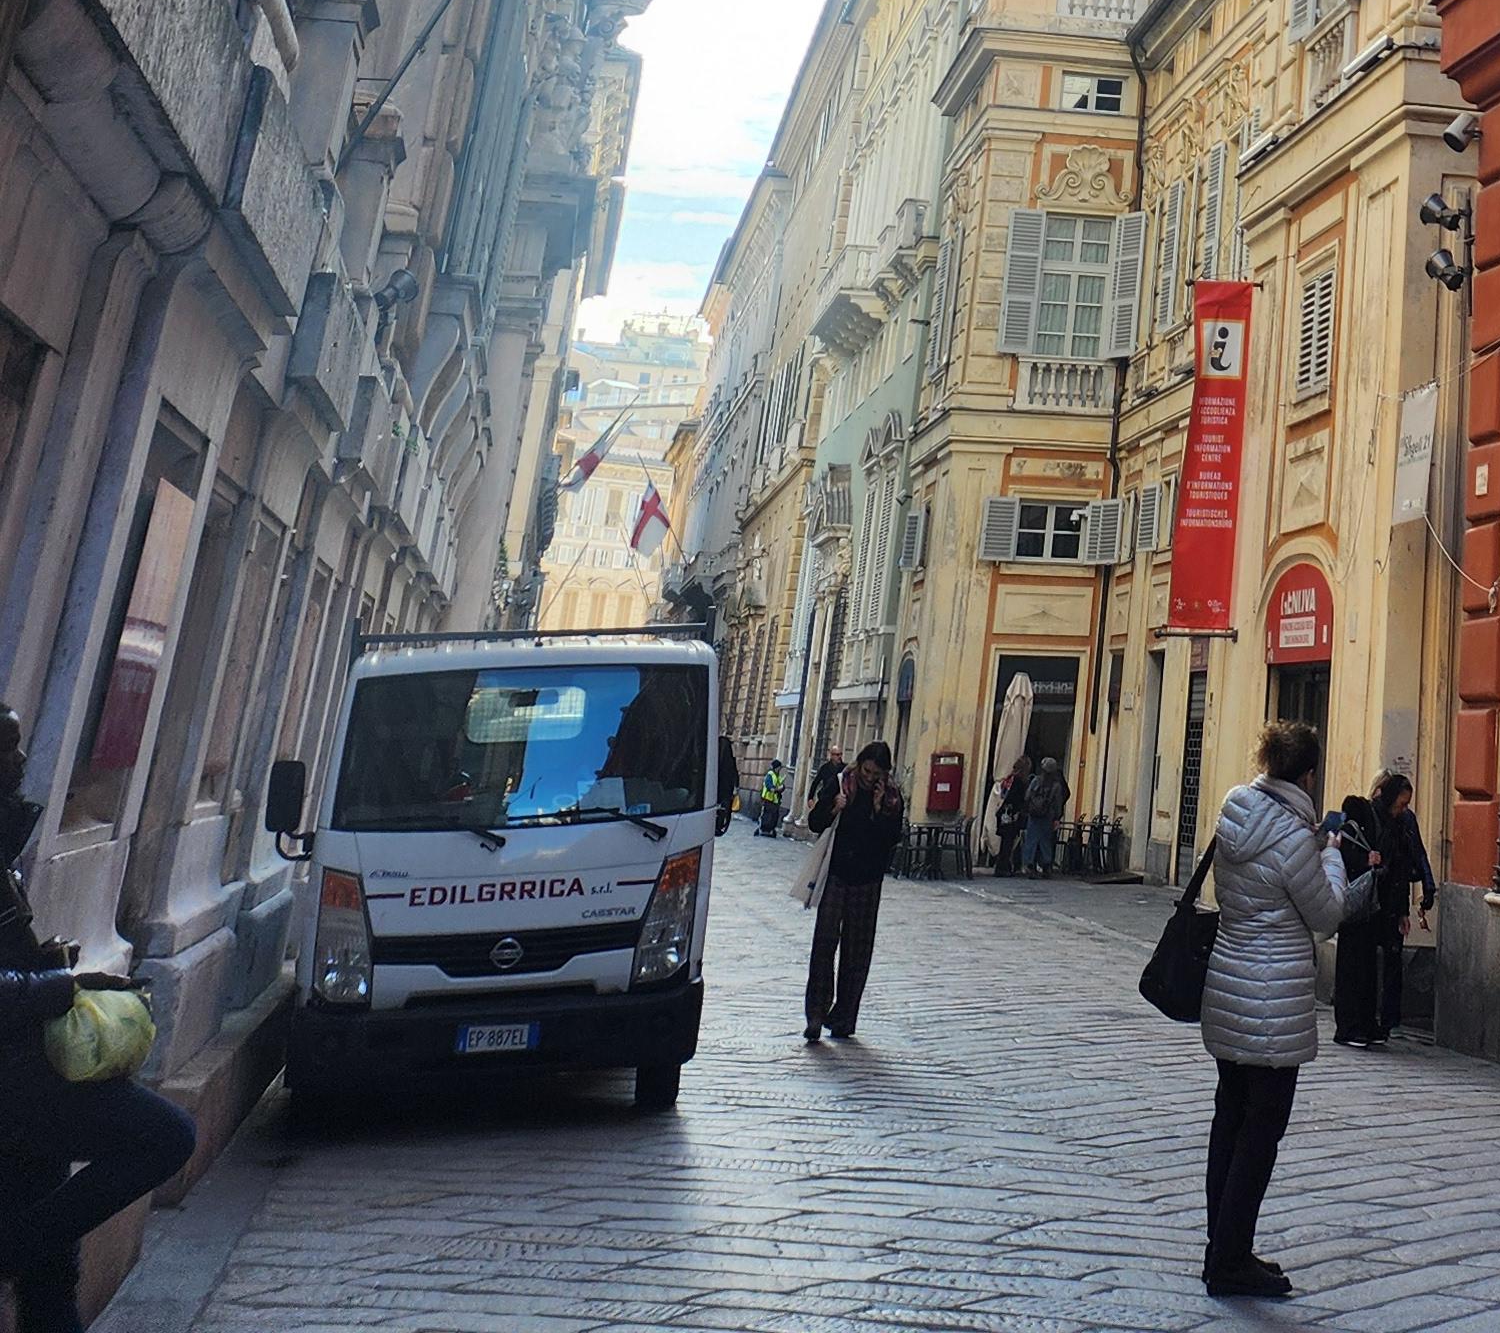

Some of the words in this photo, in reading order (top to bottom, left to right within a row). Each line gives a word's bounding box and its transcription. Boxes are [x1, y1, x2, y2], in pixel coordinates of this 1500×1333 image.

[591, 881, 613, 895] s.r.l.
[468, 1030, 485, 1048] EP
[487, 1028, 527, 1046] 887EL
